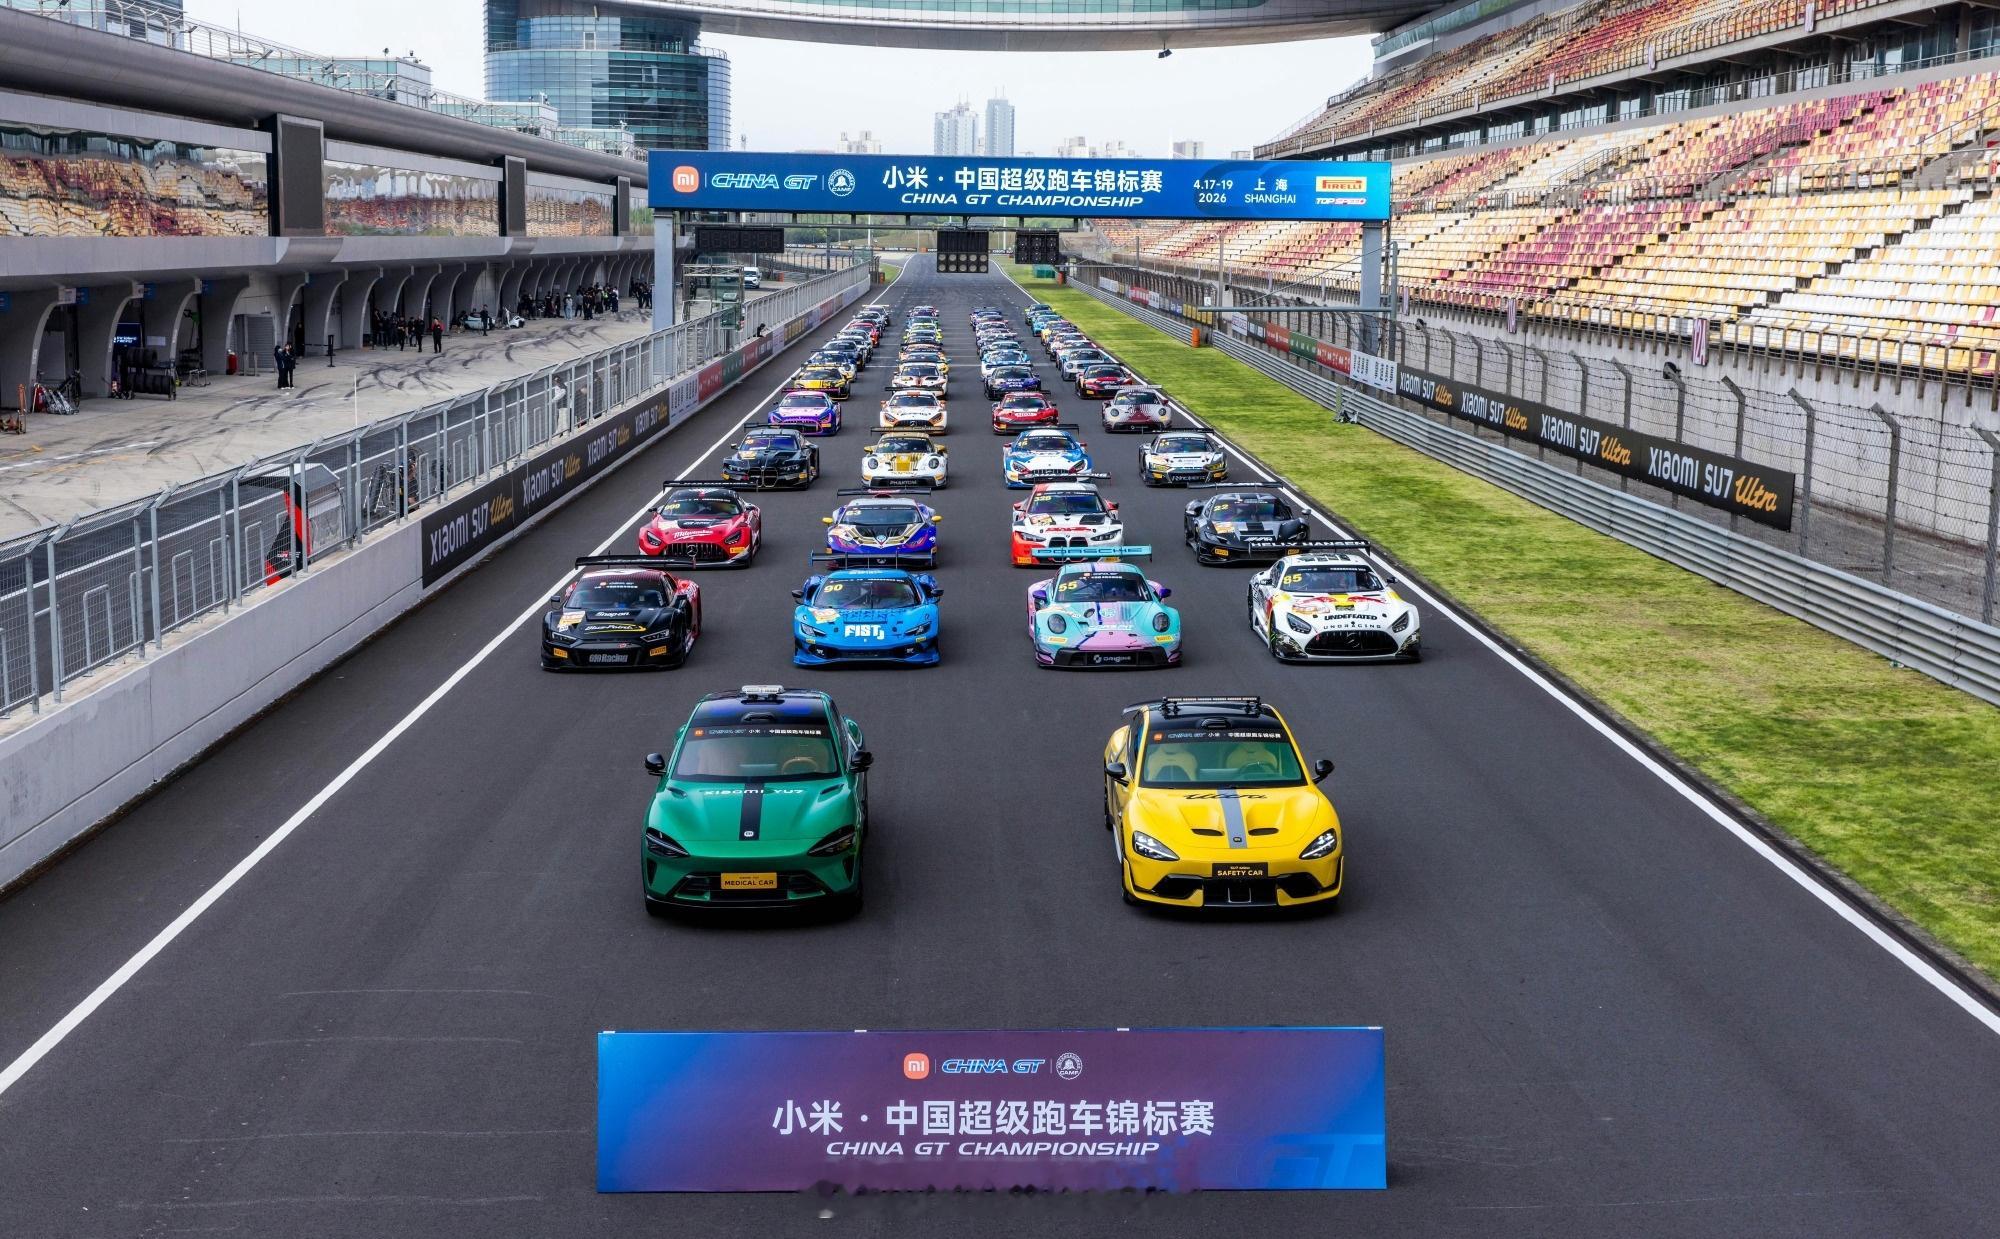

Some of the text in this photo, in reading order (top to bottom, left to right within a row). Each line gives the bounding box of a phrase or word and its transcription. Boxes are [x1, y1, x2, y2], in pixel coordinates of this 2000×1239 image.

[711, 173, 818, 190] CHINA GT
[1193, 179, 1234, 190] 4.17-19
[1321, 179, 1363, 190] PIRELLI
[901, 193, 1144, 207] CHINA GT CHAMPIONSHIP
[1198, 193, 1227, 203] 2026
[1244, 193, 1296, 204] SHANGHAI
[1489, 399, 1505, 424] SU7
[1505, 406, 1528, 431] Ultra
[1579, 426, 1600, 456] SU7
[1601, 435, 1631, 466] Ultra
[551, 458, 564, 488] SU7
[1703, 463, 1734, 499] SU7
[1735, 475, 1778, 512] Ultra
[471, 501, 489, 539] SU7
[490, 493, 513, 526] Ultra
[1283, 573, 1303, 585] 85
[823, 583, 844, 593] 90
[1058, 581, 1078, 592] 55
[1324, 613, 1378, 621] UNDEFEATED
[941, 1058, 1046, 1074] CHINA GT
[826, 1141, 1160, 1156] CHINA GT CHAMPIONSHIP
